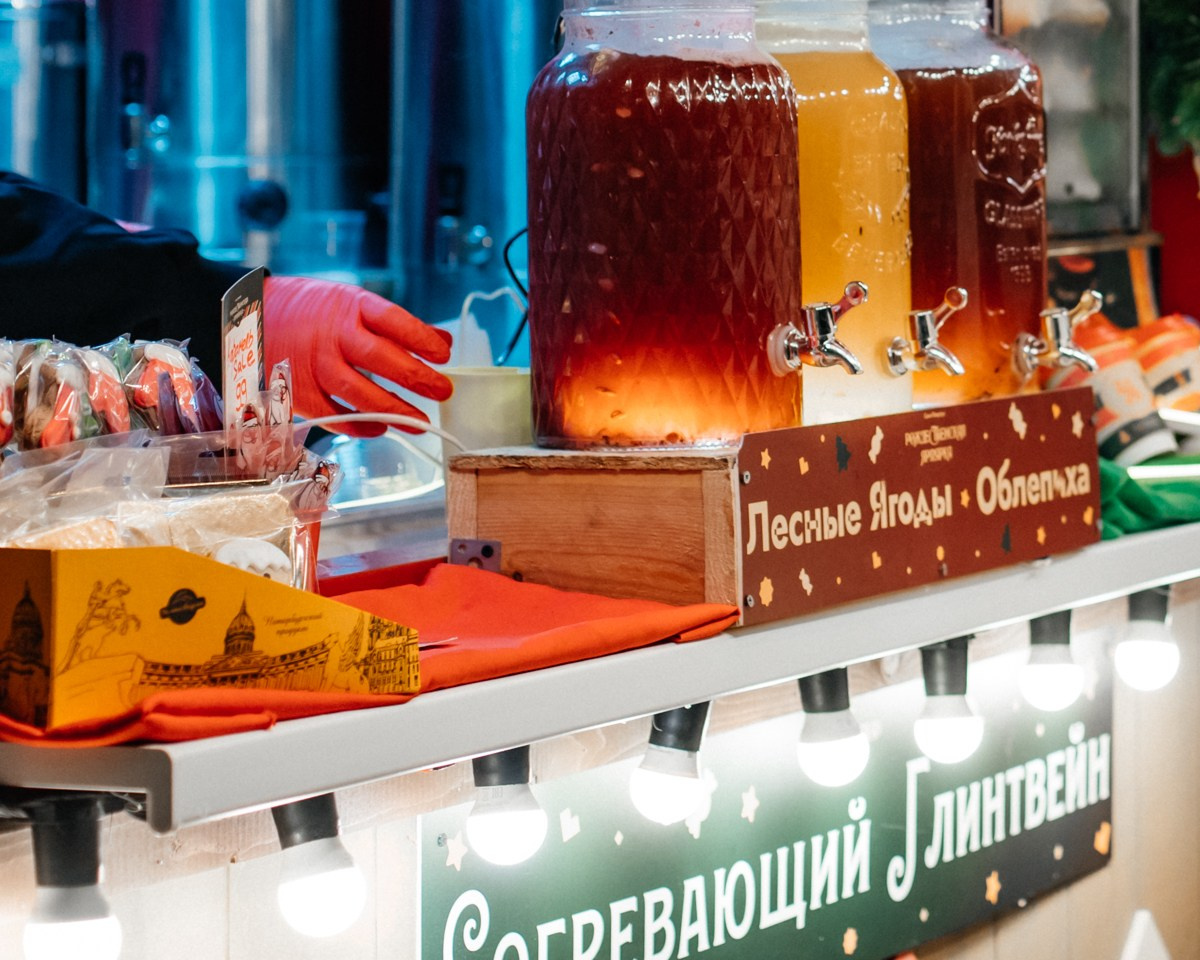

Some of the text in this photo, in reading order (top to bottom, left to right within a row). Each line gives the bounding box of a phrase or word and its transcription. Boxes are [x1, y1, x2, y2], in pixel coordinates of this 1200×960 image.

[746, 458, 1091, 555] Лесные Ягоды Облепиха
